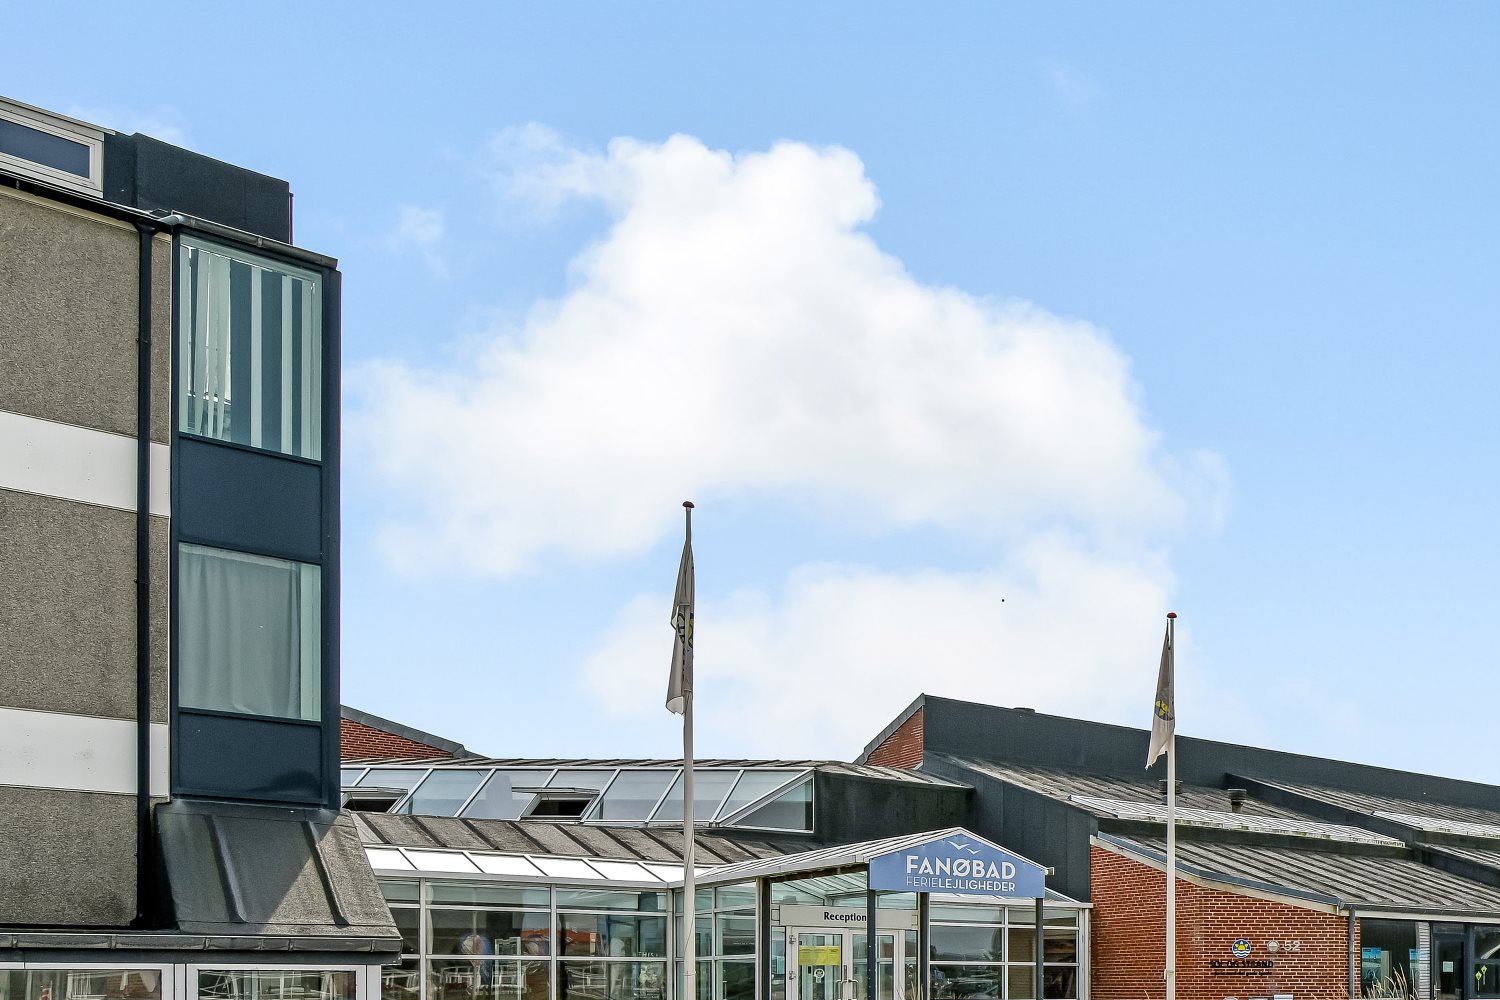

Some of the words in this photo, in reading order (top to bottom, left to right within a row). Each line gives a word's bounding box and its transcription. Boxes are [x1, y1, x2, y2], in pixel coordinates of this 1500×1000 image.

[906, 855, 1016, 879] FANØBAD
[906, 876, 1015, 891] FERIELEJLIGHEDER
[823, 911, 867, 923] Reception
